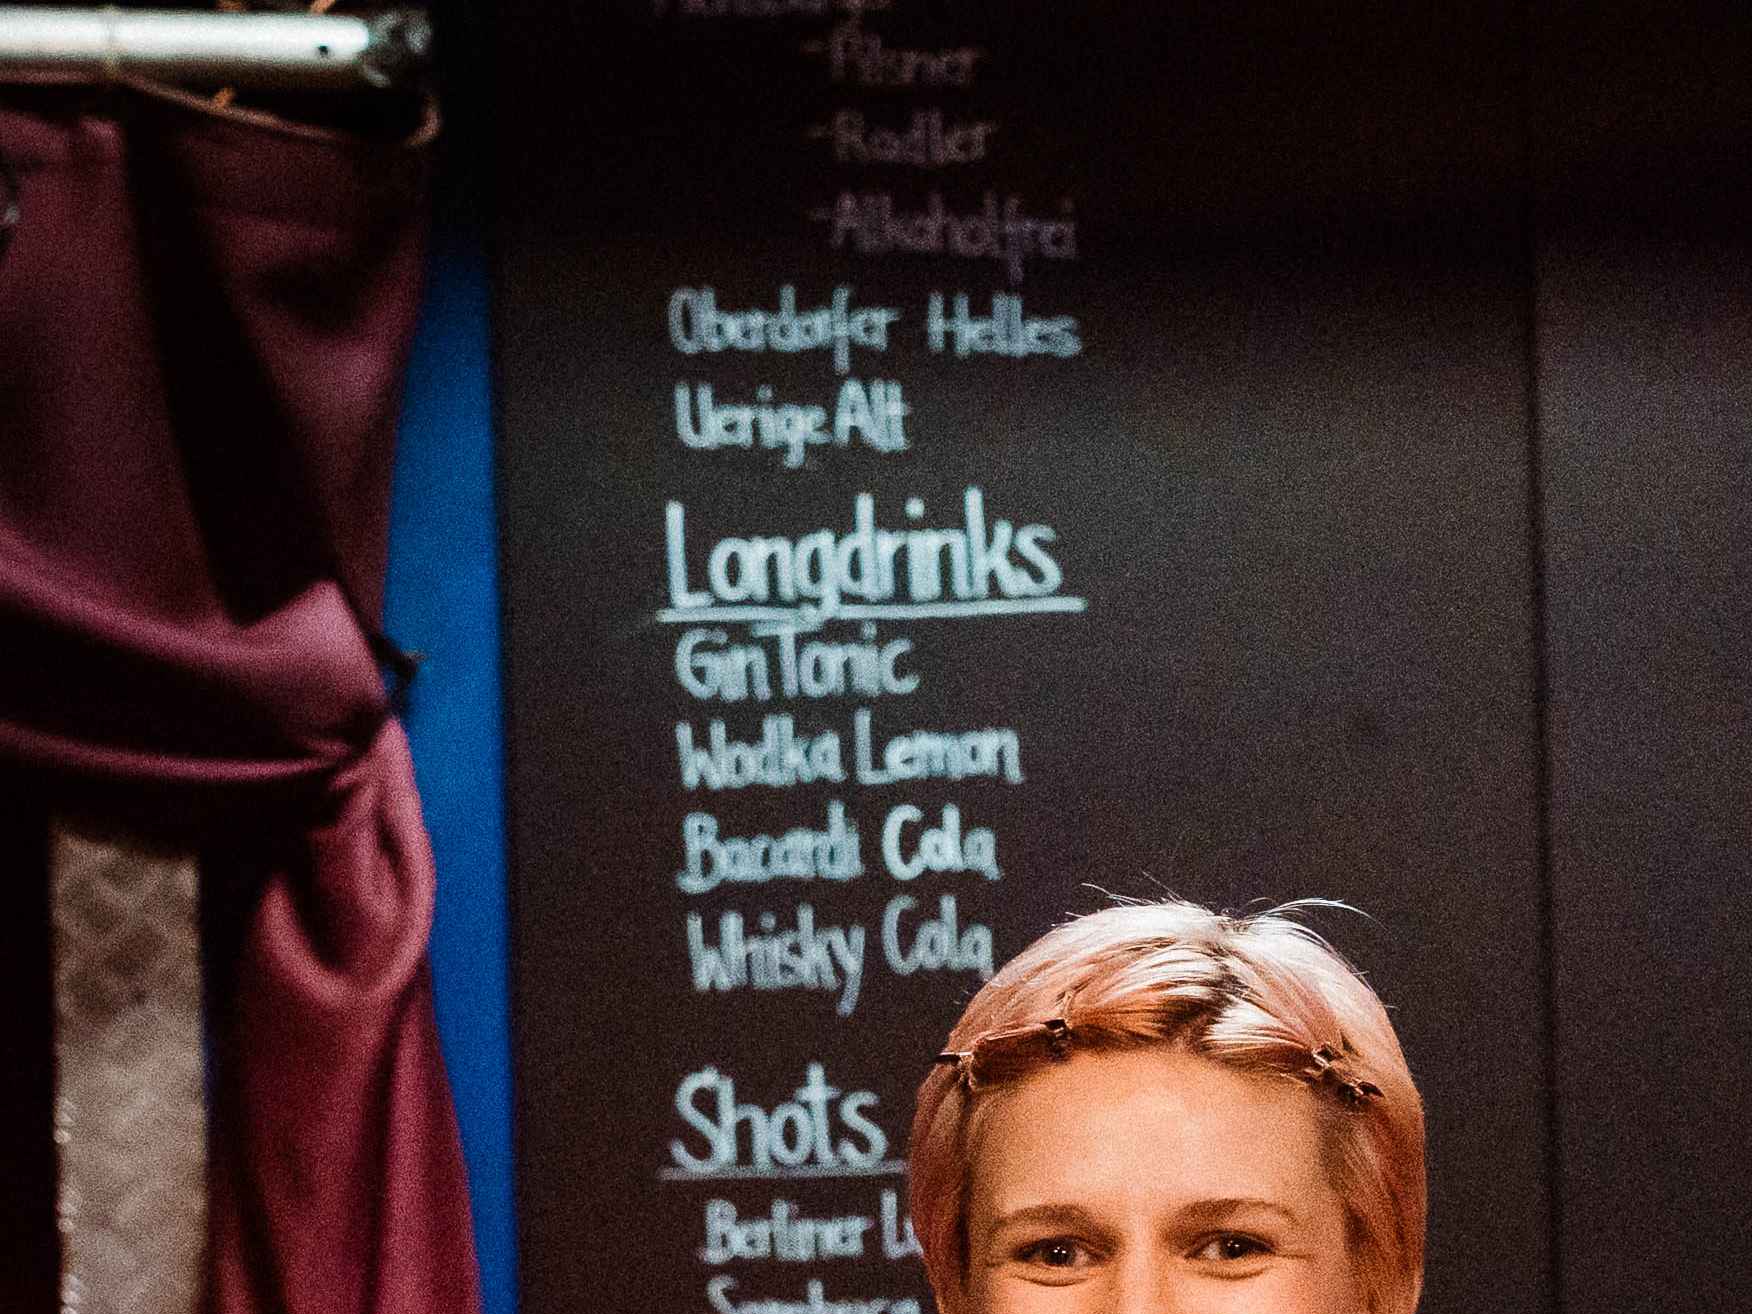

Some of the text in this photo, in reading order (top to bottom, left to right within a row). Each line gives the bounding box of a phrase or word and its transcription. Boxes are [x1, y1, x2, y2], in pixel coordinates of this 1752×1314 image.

[926, 291, 1083, 359] Helles
[665, 485, 1063, 630] Longdrinks
[675, 707, 1023, 790] Wodka Lemon
[676, 800, 1003, 893] Bacardi Cola
[687, 895, 995, 1018] Whisky Cola
[671, 1061, 889, 1174] Shots
[698, 1198, 873, 1264] Berliner
